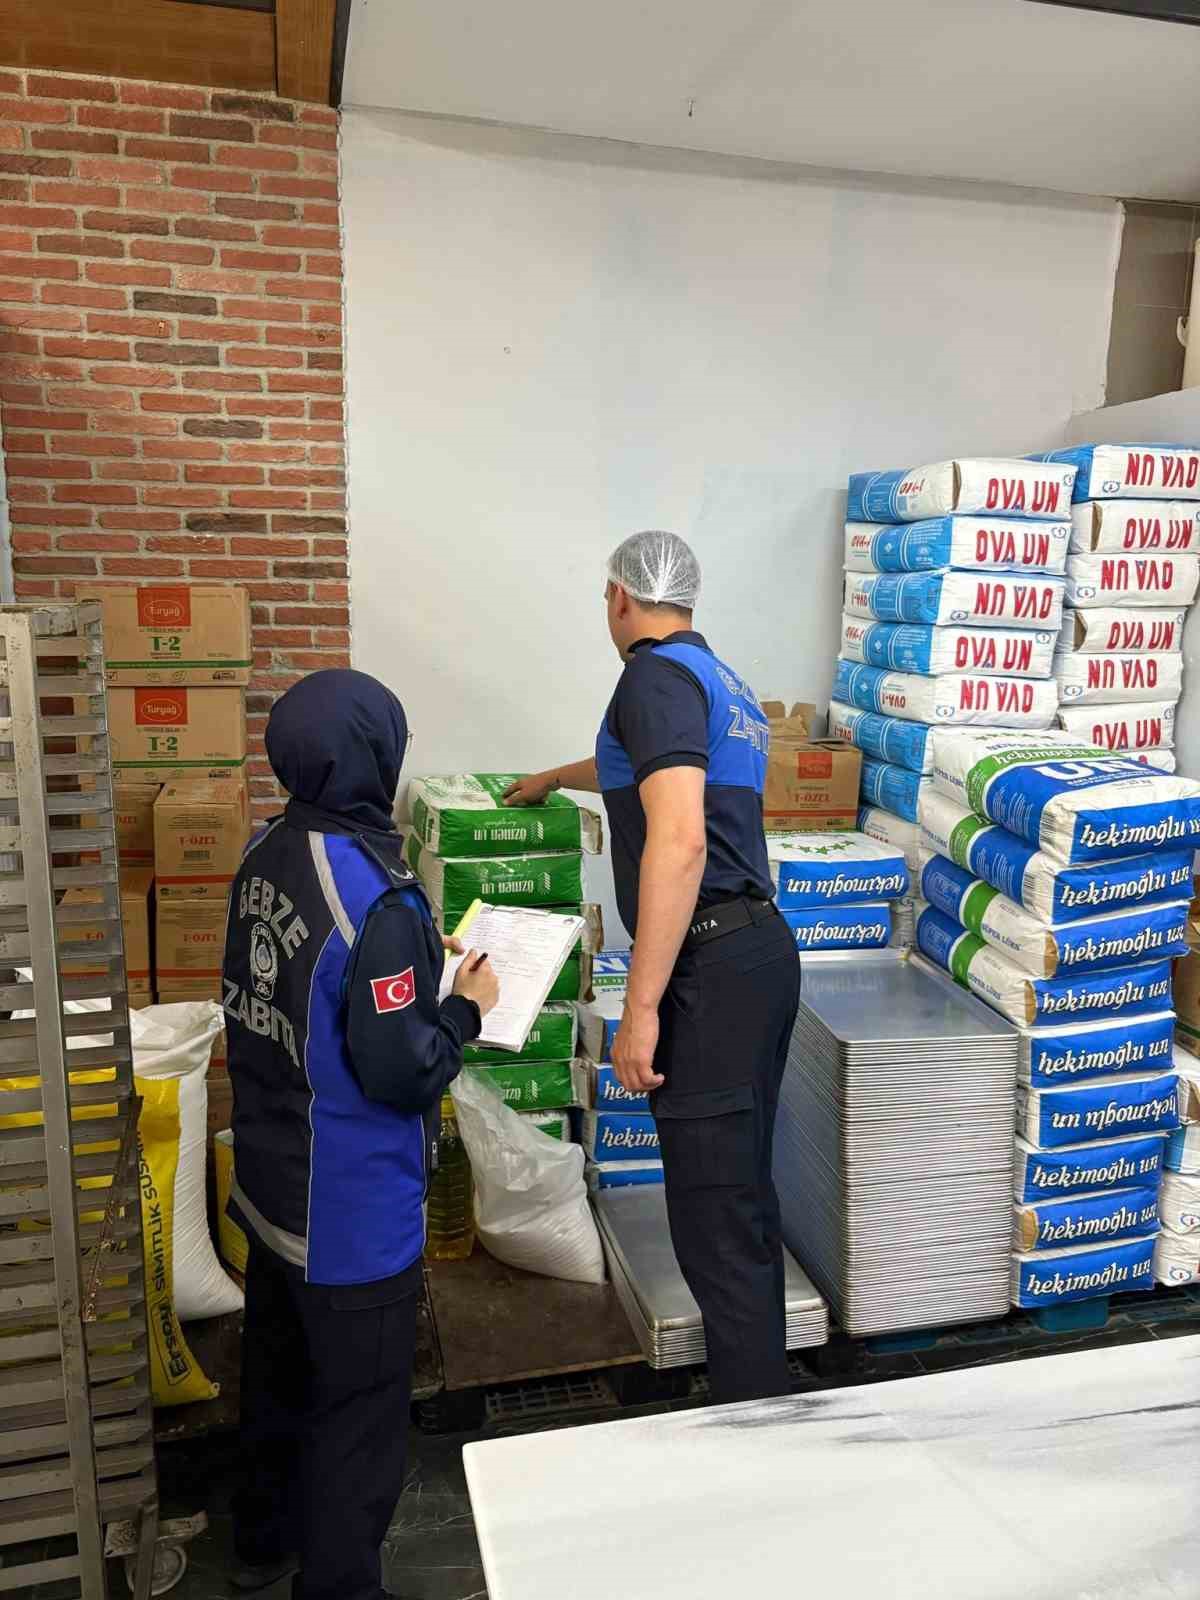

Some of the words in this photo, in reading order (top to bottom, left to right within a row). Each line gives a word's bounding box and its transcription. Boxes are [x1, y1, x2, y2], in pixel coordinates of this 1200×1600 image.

[1125, 453, 1155, 486] UN
[1161, 455, 1199, 488] OVA
[986, 478, 1026, 511] OVA
[1032, 481, 1060, 513] UN
[976, 529, 1016, 563] OVA
[1022, 533, 1050, 566] UN
[1123, 518, 1161, 549] OVA
[1166, 519, 1193, 549] UN
[1101, 559, 1129, 591] UN
[1134, 559, 1173, 591] OVA
[974, 582, 1006, 616] UN
[1013, 585, 1054, 619] OVA
[151, 636, 181, 651] T-2
[1106, 621, 1144, 650] OVA
[1148, 621, 1175, 650] UN
[955, 636, 996, 668] OVA
[1002, 639, 1033, 671] UN
[1087, 659, 1115, 689] UN
[1120, 659, 1158, 689] OVA
[959, 680, 989, 711] UN
[995, 682, 1034, 713] OVA
[148, 736, 178, 751] T-2
[1135, 718, 1162, 748] UN
[1080, 816, 1186, 848] hekimoğlu
[787, 878, 812, 893] un
[1060, 869, 1166, 907] hekimoğlu
[1170, 865, 1190, 885] un
[239, 877, 310, 960] GEBZE
[1063, 928, 1162, 965] hekimoğlu
[1167, 924, 1185, 944] un
[1041, 982, 1144, 1014] hekimoğlu
[1149, 980, 1168, 997] un
[1038, 1041, 1143, 1073] hekimoğlu
[1149, 1038, 1169, 1055] un
[1052, 1112, 1081, 1129] un
[602, 1126, 660, 1148] hekim
[1032, 1157, 1136, 1189] hekimoğlu
[1139, 1154, 1160, 1173] un
[1041, 1206, 1137, 1242] hekimoğlu
[1027, 1262, 1129, 1296] hekimoğlu
[1132, 1258, 1151, 1279] un
